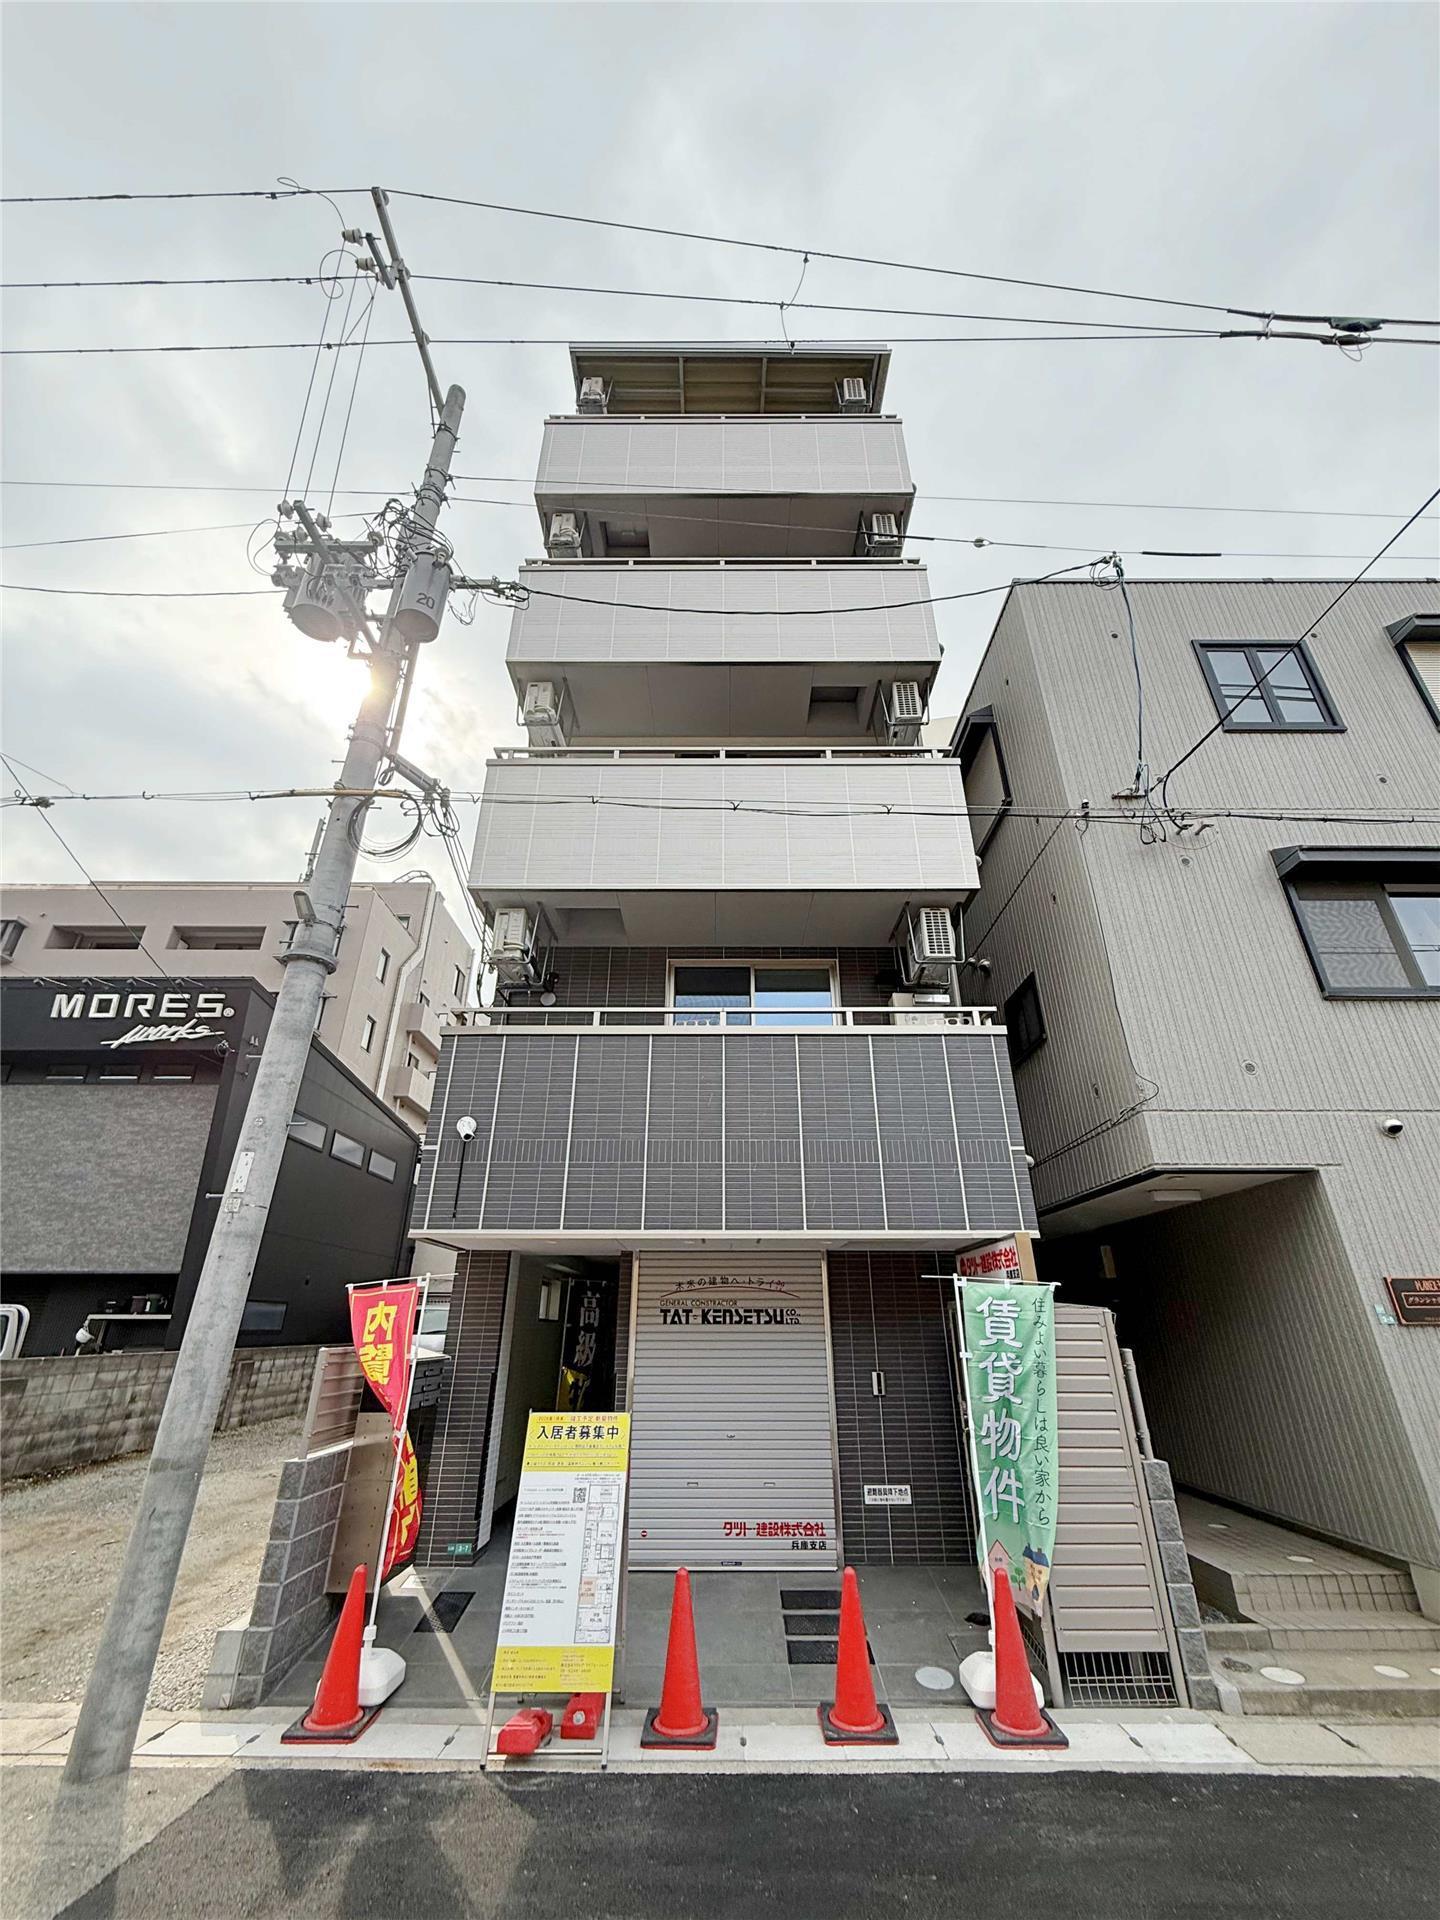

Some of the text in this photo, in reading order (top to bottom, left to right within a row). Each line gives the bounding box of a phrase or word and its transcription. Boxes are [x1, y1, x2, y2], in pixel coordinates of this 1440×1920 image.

[416, 592, 436, 610] 20
[976, 1296, 1026, 1524] 賃貸物件
[1032, 1297, 1052, 1526] 住みよい暮らしは良い家から
[536, 1425, 620, 1440] 入居者募集中
[791, 1540, 827, 1550] 兵庫支店
